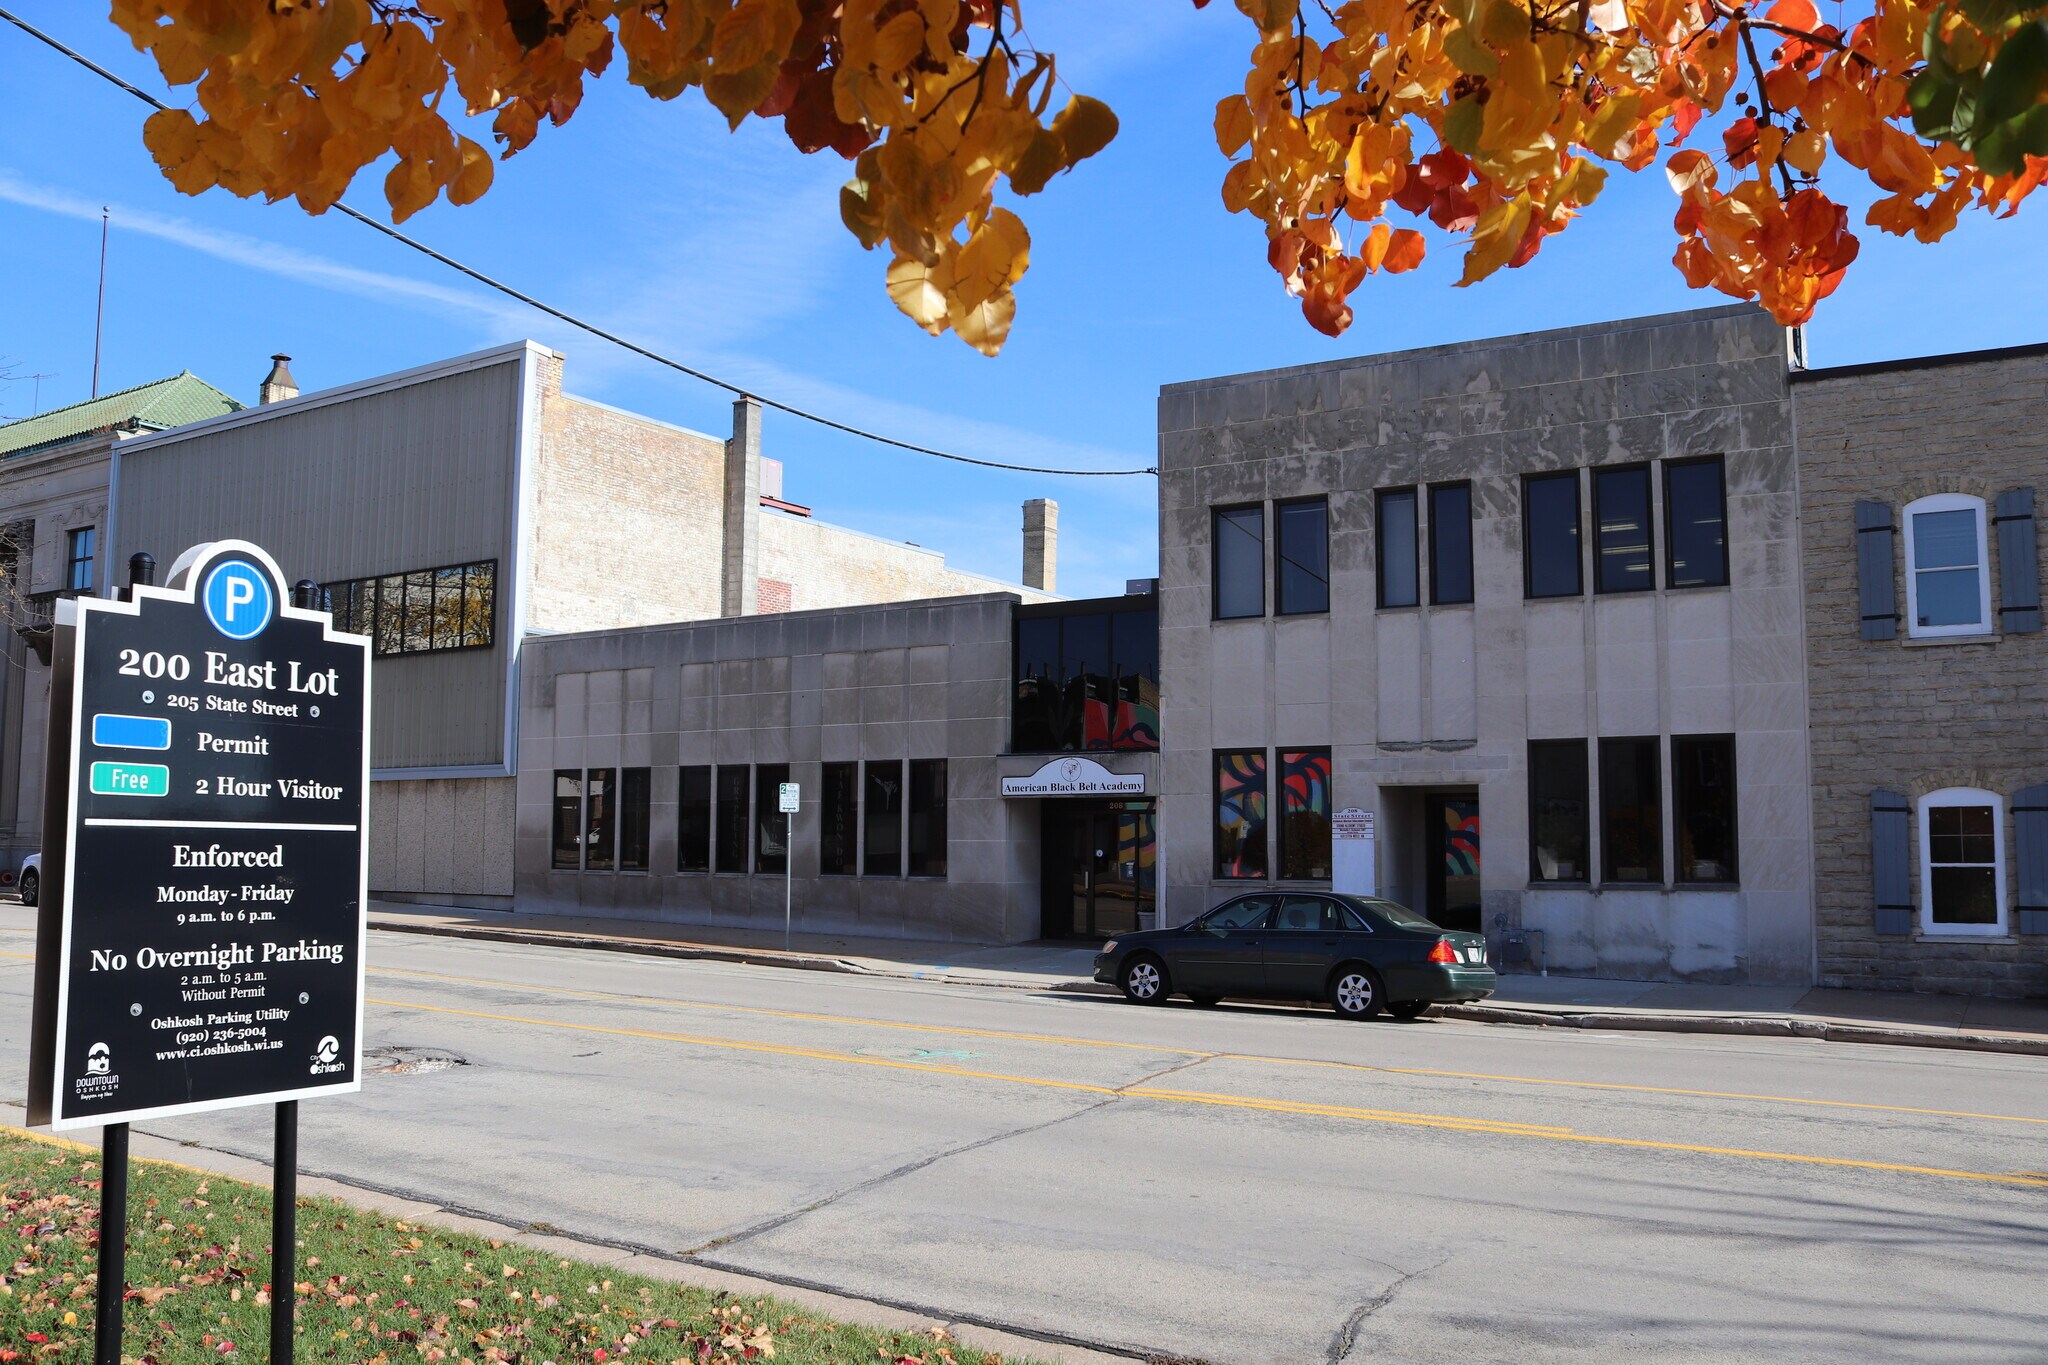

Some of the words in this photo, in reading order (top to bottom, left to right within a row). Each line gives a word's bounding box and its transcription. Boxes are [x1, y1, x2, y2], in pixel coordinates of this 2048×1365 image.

[226, 576, 254, 622] P
[119, 649, 190, 681] 200
[204, 651, 276, 689] East
[288, 661, 338, 697] Lot
[167, 694, 199, 711] 205
[206, 695, 247, 713] State
[252, 699, 298, 717] Street
[197, 732, 269, 755] Permit
[112, 768, 149, 790] Free
[196, 780, 208, 795] 2
[216, 777, 271, 797] Hour
[277, 779, 343, 800] Visitor
[1004, 784, 1048, 793] American
[1050, 783, 1076, 792] Black
[1079, 783, 1097, 791] Belt
[1099, 782, 1143, 792] Academy
[173, 844, 283, 867] Enforced
[177, 914, 185, 926] 9
[189, 912, 217, 923] a.m.
[221, 911, 233, 922] to
[238, 910, 245, 921] 6
[249, 911, 276, 924] p.m.
[90, 950, 127, 971] No
[137, 943, 254, 969] Overnight
[261, 939, 344, 963] Parking
[181, 977, 188, 986] 2
[192, 975, 215, 985] a.m.
[220, 973, 231, 983] to
[234, 973, 241, 984] 5
[245, 972, 266, 982] a.m.
[182, 989, 226, 1002] Without
[230, 985, 265, 999] Permit
[151, 1015, 203, 1030] Oshkosh
[208, 1011, 252, 1026] Parking
[256, 1008, 290, 1022] Utility
[176, 1030, 209, 1044] (920)
[213, 1026, 267, 1040] 236-5004
[156, 1038, 283, 1060] www.ci.oshkosh.wi.us
[310, 1062, 345, 1074] Oshkosh
[76, 1084, 119, 1093] OSHKOSH
